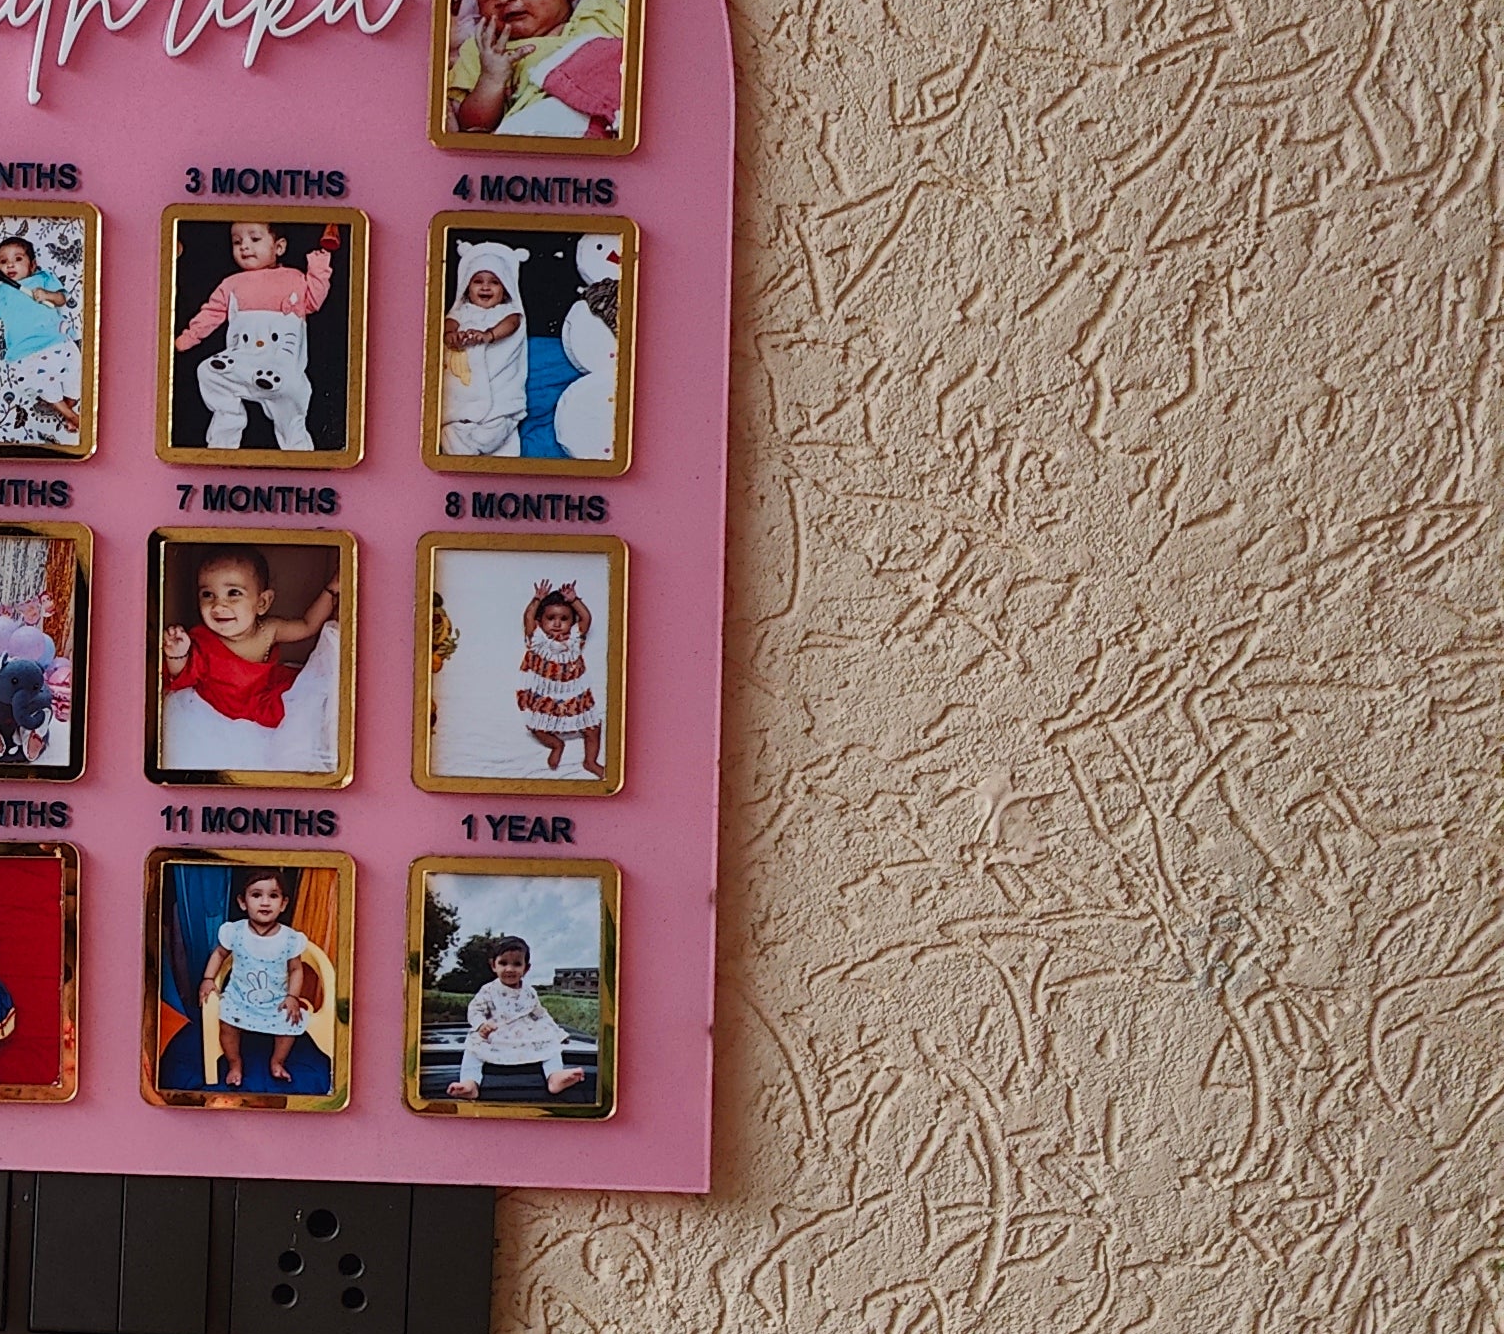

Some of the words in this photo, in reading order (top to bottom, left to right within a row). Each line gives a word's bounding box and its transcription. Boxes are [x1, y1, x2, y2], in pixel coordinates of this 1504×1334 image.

[186, 168, 201, 193] 3
[212, 168, 345, 197] MONTHS
[453, 175, 471, 200] 4
[481, 175, 614, 205] MONTHS
[177, 485, 192, 509] 7
[203, 485, 337, 515] MONTHS
[446, 492, 464, 517] 8
[472, 492, 606, 521] MONTHS
[161, 806, 189, 831] 11
[202, 807, 336, 836] MONTHS
[462, 815, 473, 839] 1
[486, 815, 572, 842] YEAR
